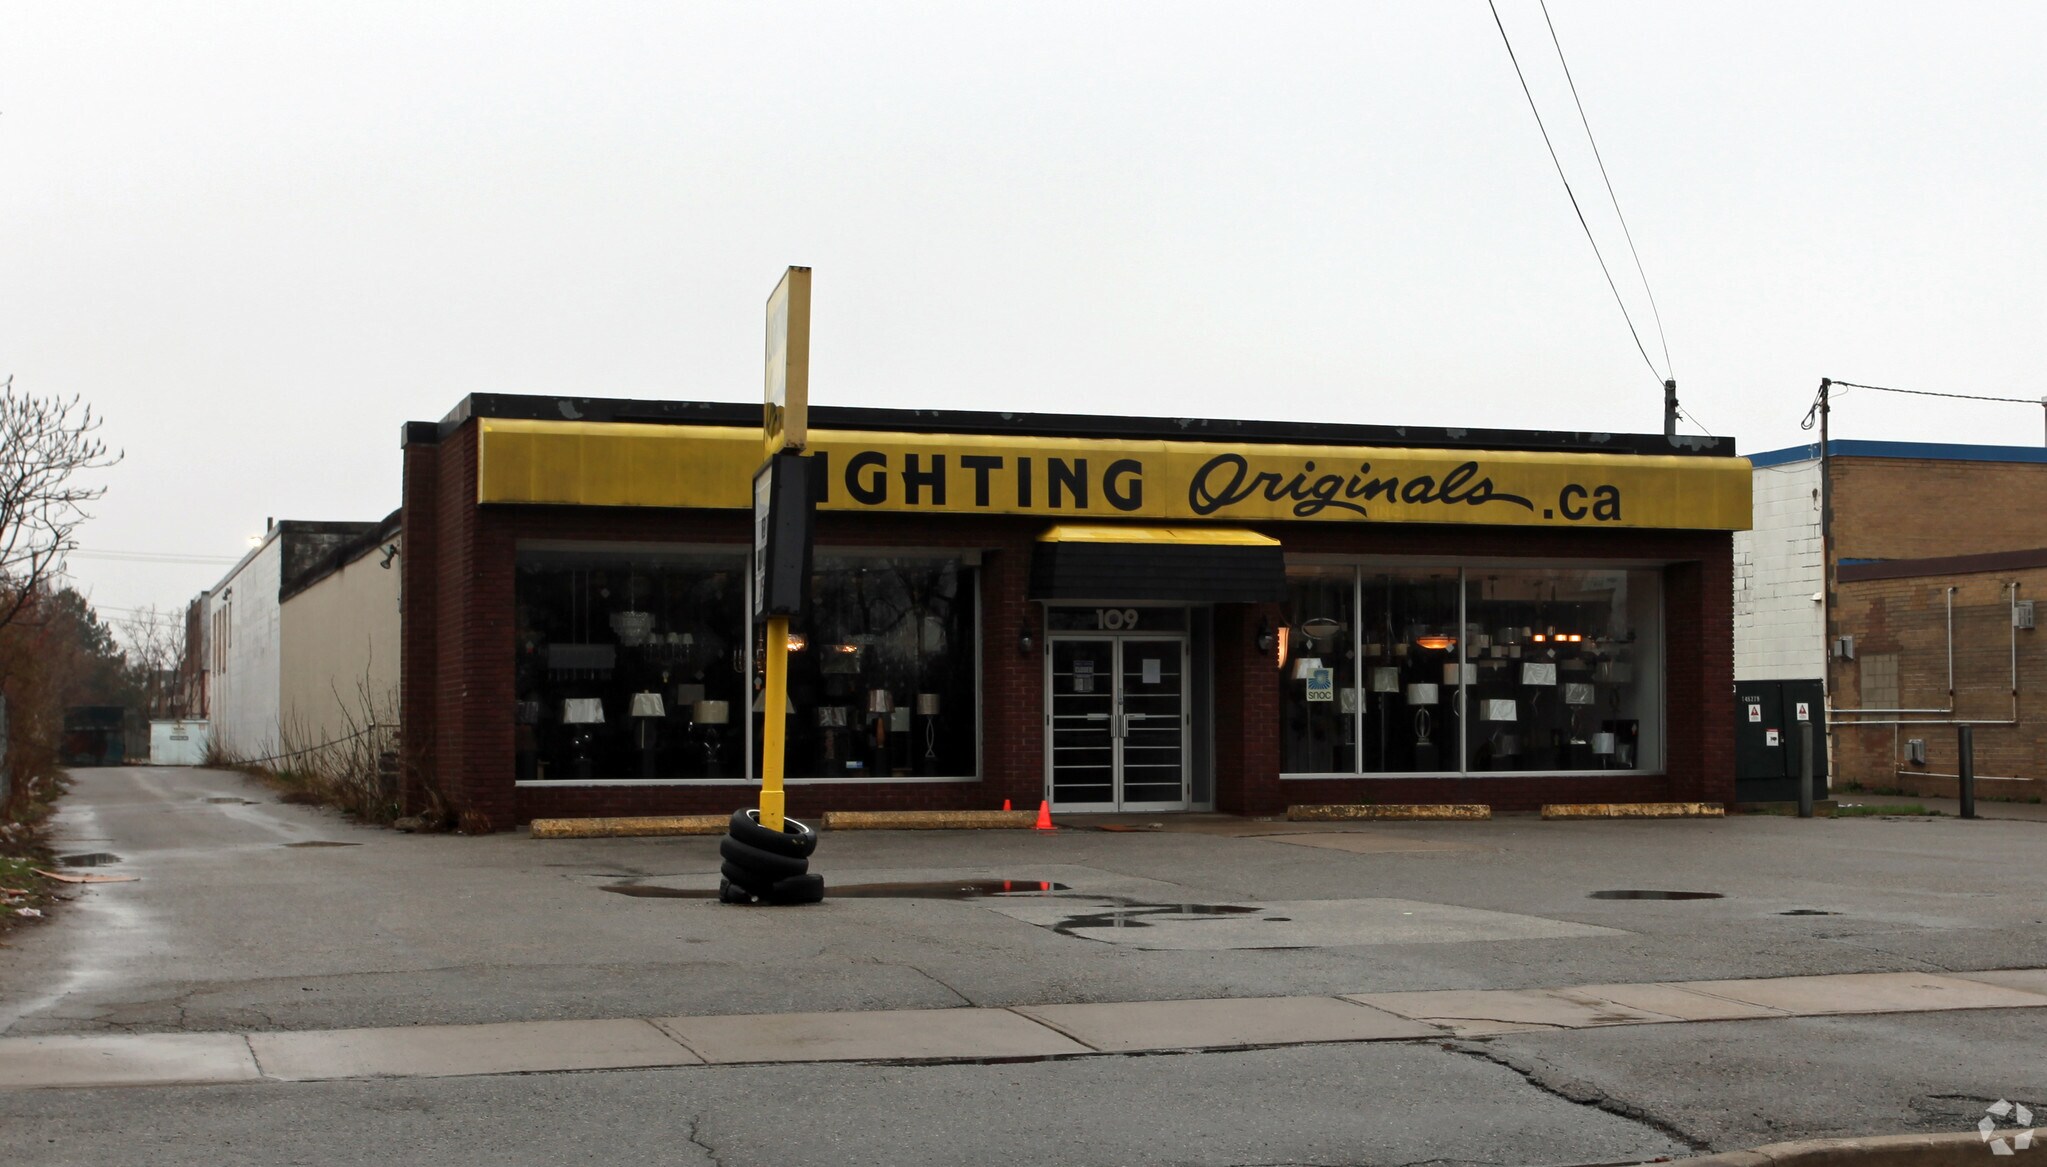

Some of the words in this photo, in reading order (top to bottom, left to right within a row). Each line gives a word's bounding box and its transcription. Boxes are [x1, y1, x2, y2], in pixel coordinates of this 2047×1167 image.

[814, 451, 1143, 512] IGHTING
[1189, 454, 1534, 518] Originals
[1544, 484, 1622, 521] .ca
[1096, 608, 1139, 630] 109
